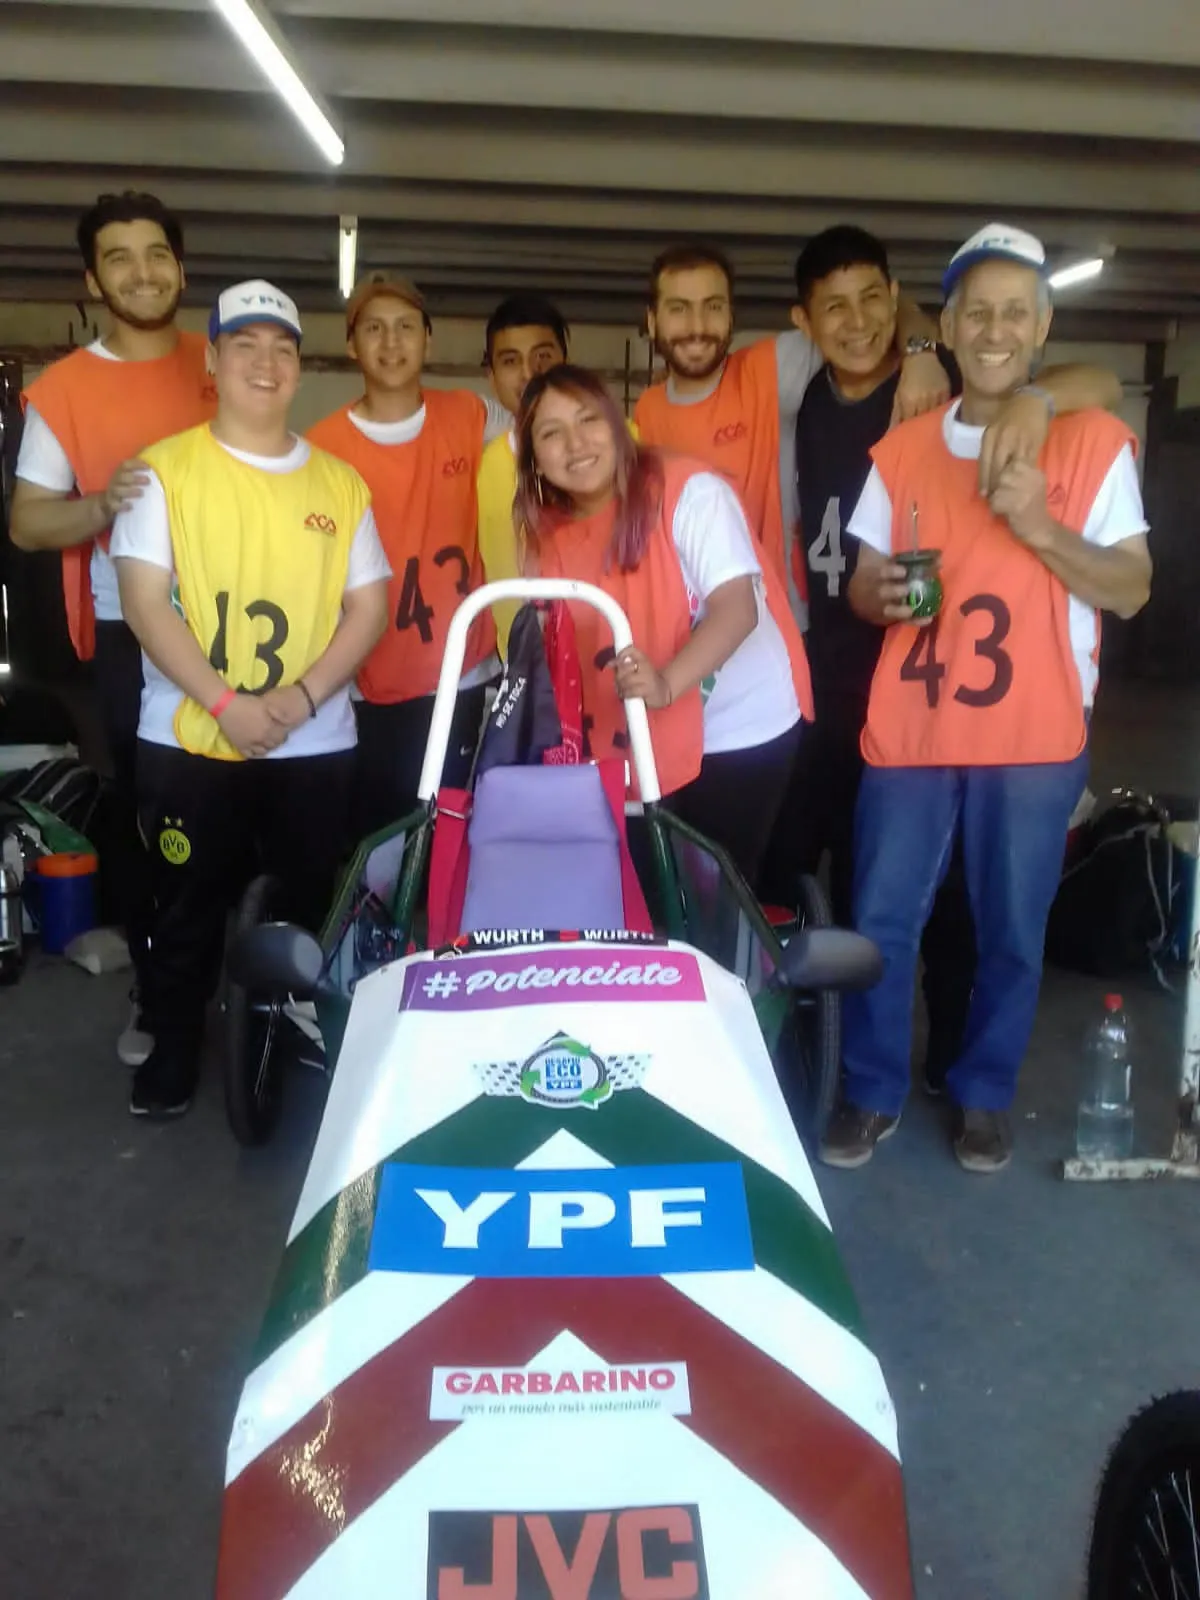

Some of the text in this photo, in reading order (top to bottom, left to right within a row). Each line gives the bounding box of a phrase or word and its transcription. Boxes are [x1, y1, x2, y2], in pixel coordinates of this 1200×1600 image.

[900, 593, 1013, 710] 43
[422, 961, 682, 999] #Potenciate
[545, 1064, 582, 1078] ECO
[413, 1187, 706, 1249] YPF
[445, 1368, 676, 1396] GARBARINO
[438, 1506, 699, 1600] JVC
